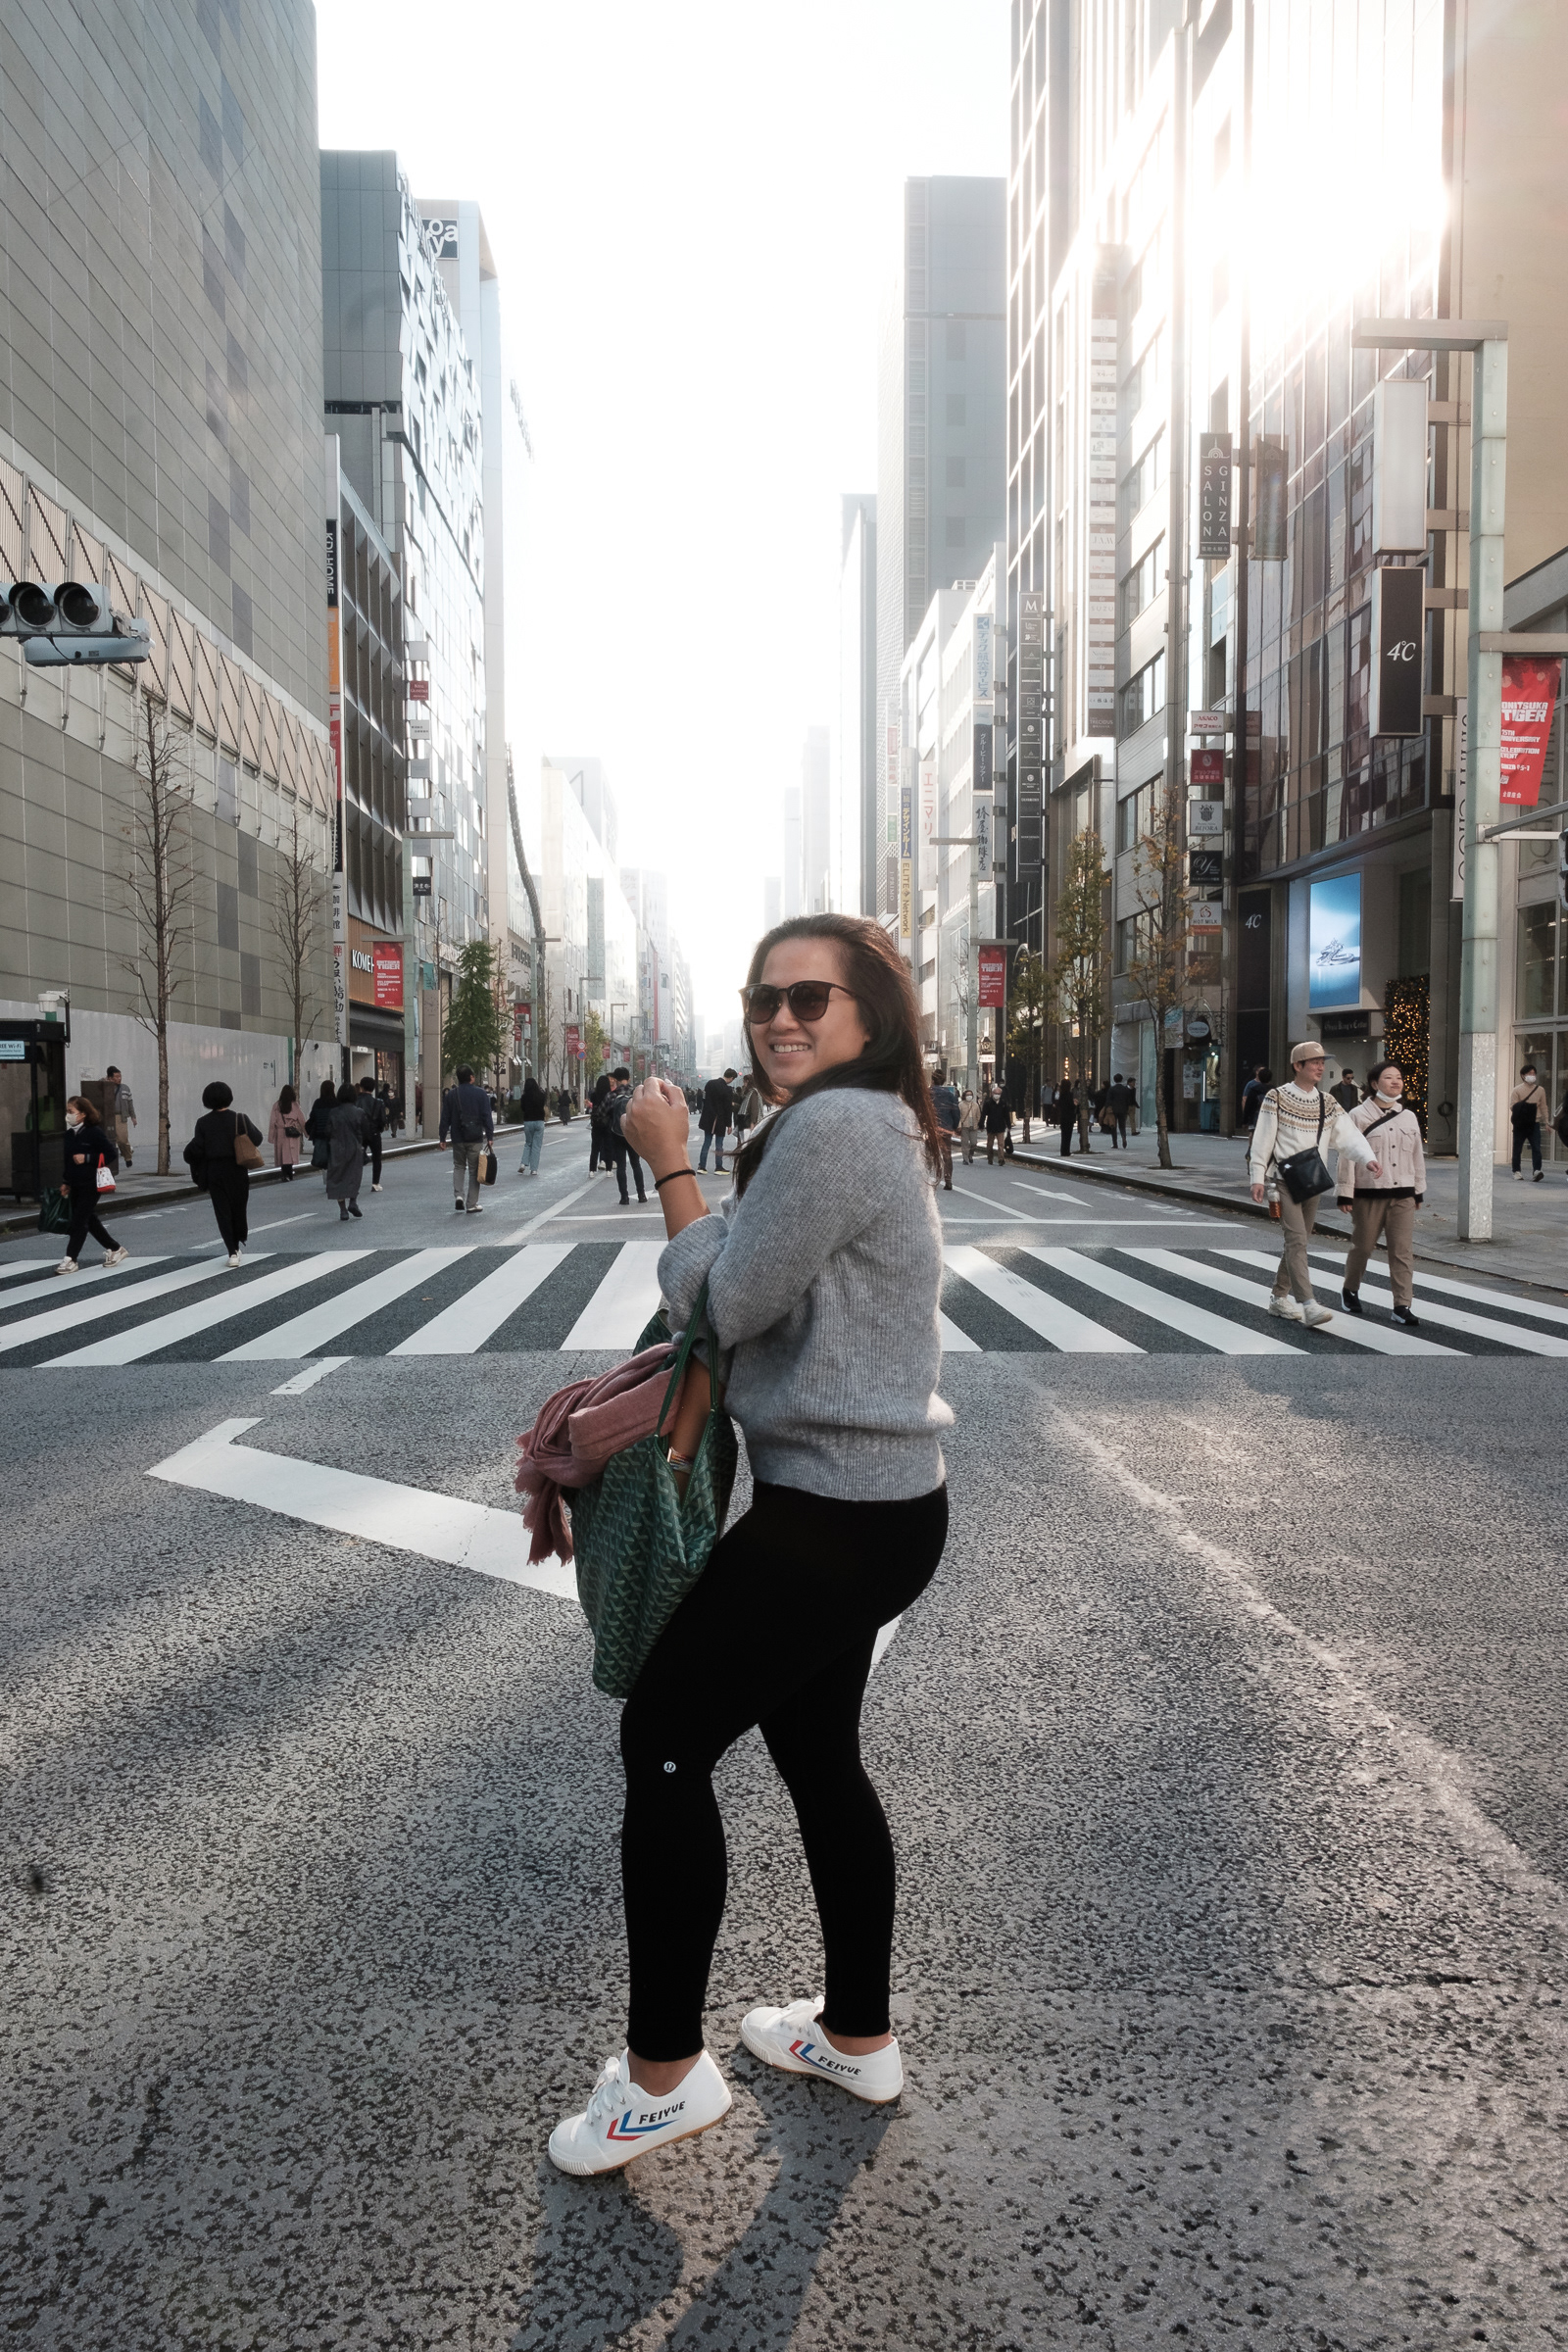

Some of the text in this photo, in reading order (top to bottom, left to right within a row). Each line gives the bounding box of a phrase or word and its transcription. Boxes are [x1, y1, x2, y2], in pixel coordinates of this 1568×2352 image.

[1202, 466, 1212, 536] SALON
[1218, 466, 1228, 536] GINZA
[1024, 600, 1038, 612] M
[1501, 710, 1546, 722] TIGER
[818, 2055, 861, 2075] FEIYUE
[639, 2100, 685, 2125] FEIYUE
